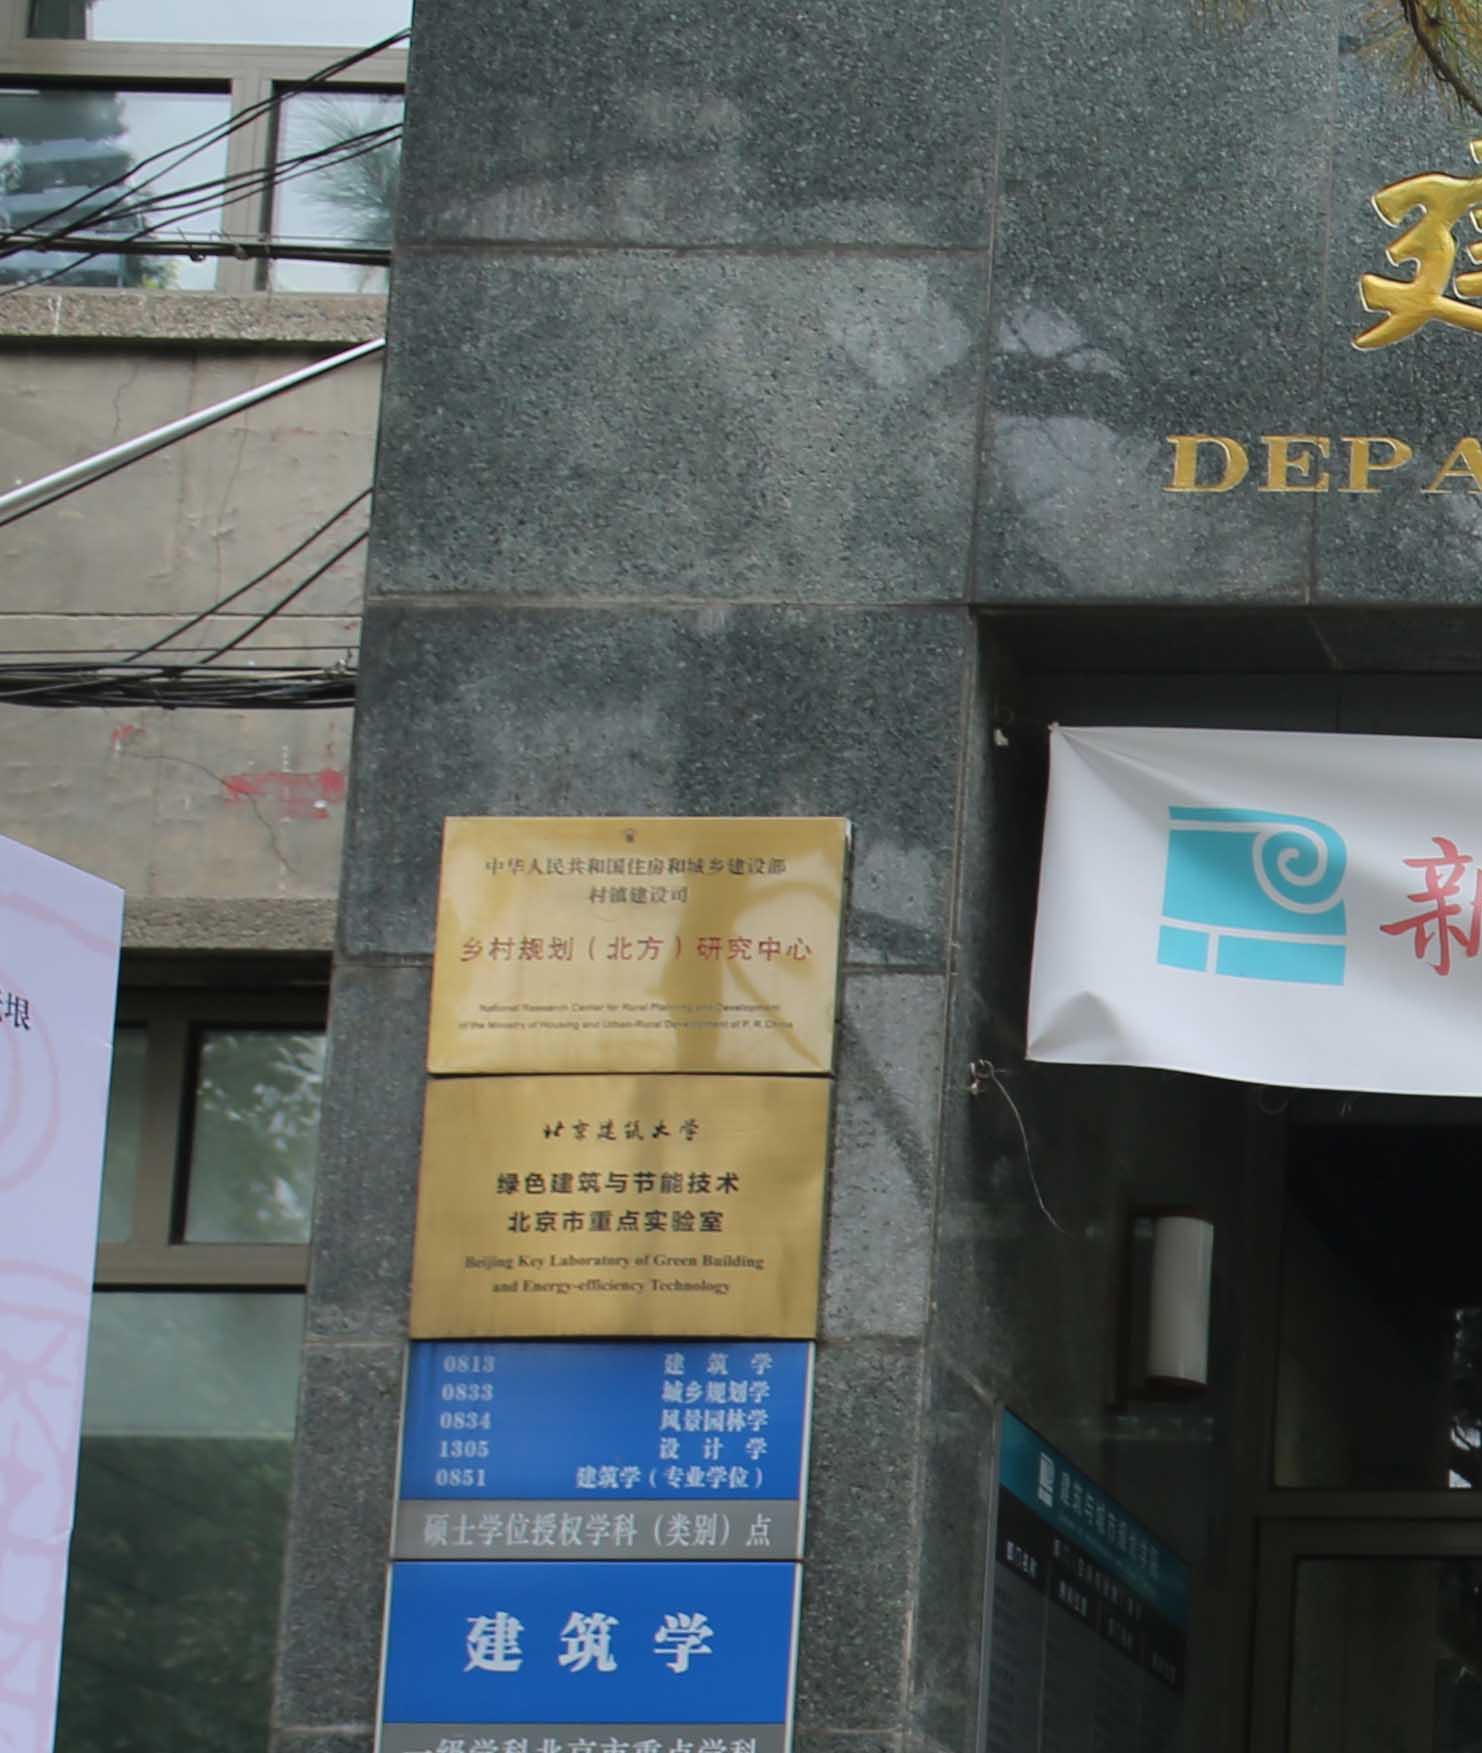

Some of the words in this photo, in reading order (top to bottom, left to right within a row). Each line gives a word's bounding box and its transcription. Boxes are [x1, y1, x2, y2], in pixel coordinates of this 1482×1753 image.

[460, 935, 812, 962] 乡村规划（北方）研究中心
[496, 1171, 740, 1195] 绿色建筑与节能技术
[507, 1210, 724, 1233] 北京市重点实验室
[465, 1255, 513, 1270] Beijing
[517, 1255, 544, 1270] Key
[550, 1254, 633, 1270] Laboratory
[635, 1254, 651, 1266] of
[653, 1254, 697, 1267] Green
[702, 1255, 765, 1270] Building
[493, 1280, 518, 1293] and
[651, 1279, 730, 1295] Technology
[443, 1355, 495, 1373] 0813
[664, 1352, 773, 1376] 建筑学
[441, 1383, 494, 1401] 0833
[661, 1380, 770, 1403] 城乡规划学
[440, 1411, 492, 1429] 0834
[659, 1409, 769, 1432] 风景园林学
[440, 1440, 489, 1458] 1305
[659, 1438, 768, 1460] 设计学
[435, 1469, 487, 1487] 0851
[423, 1513, 772, 1547] 硕士学位授权学科（类别）点
[463, 1611, 714, 1673] 建筑学
